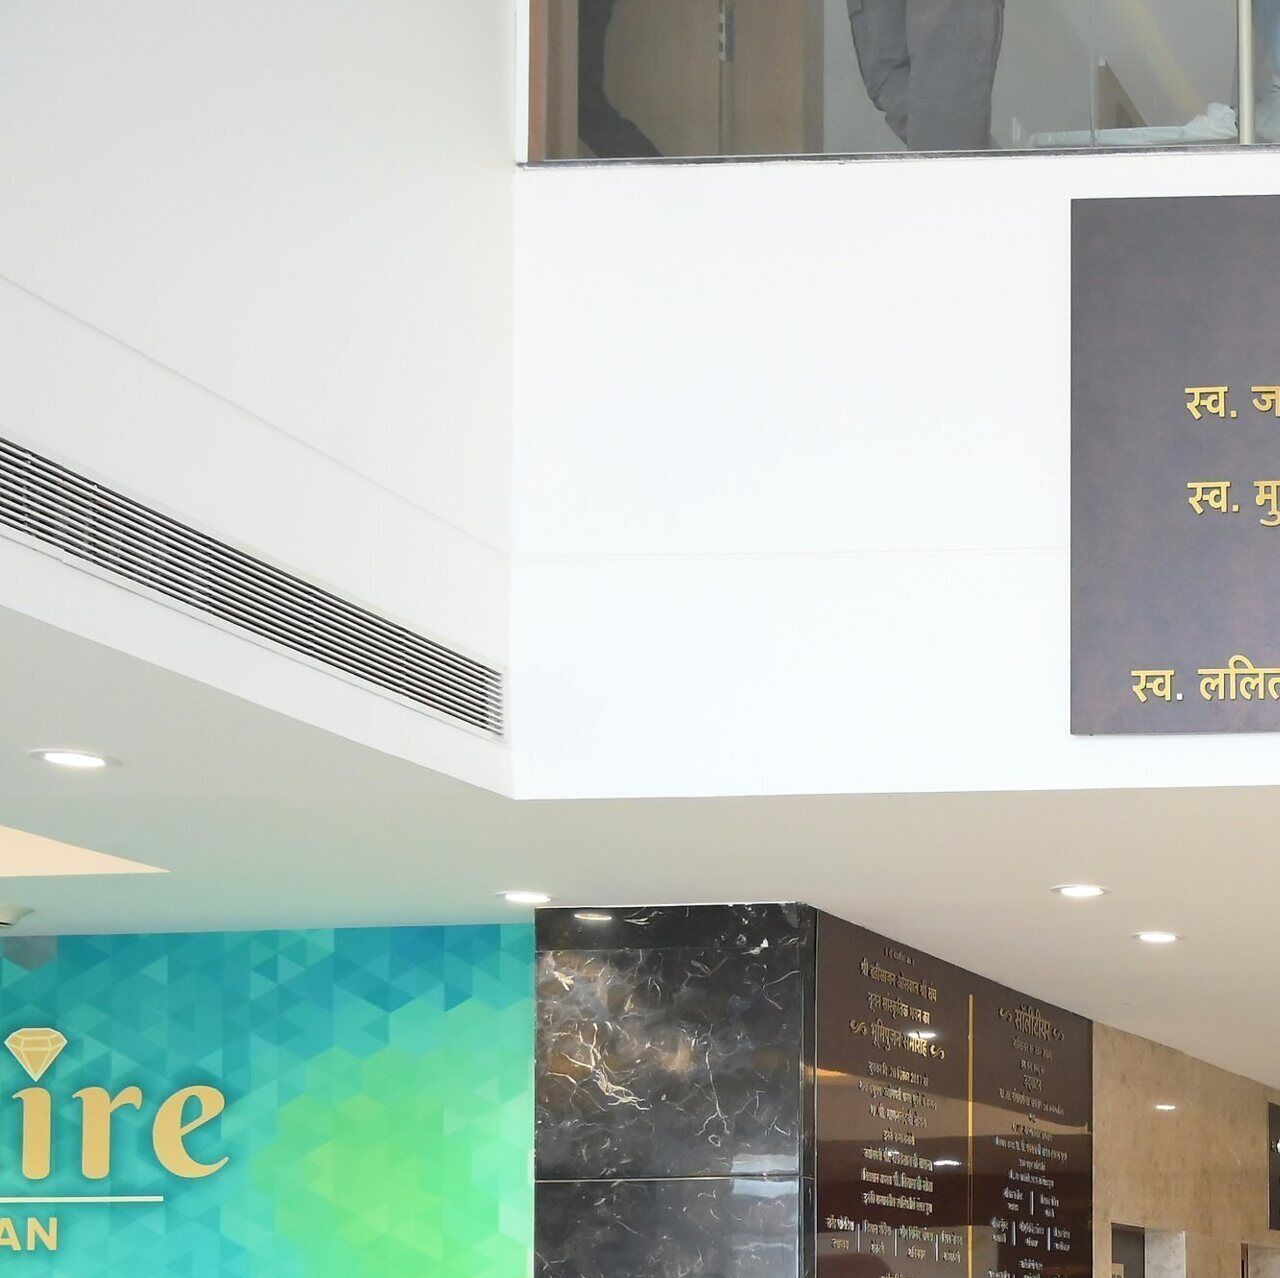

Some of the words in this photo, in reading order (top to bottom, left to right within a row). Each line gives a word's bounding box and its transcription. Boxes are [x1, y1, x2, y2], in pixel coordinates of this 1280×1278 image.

[1185, 385, 1238, 420] स्व.
[1187, 480, 1239, 514] स्व.
[1131, 669, 1183, 703] स्व.
[11, 1084, 229, 1180] ire
[0, 1216, 59, 1251] AN
